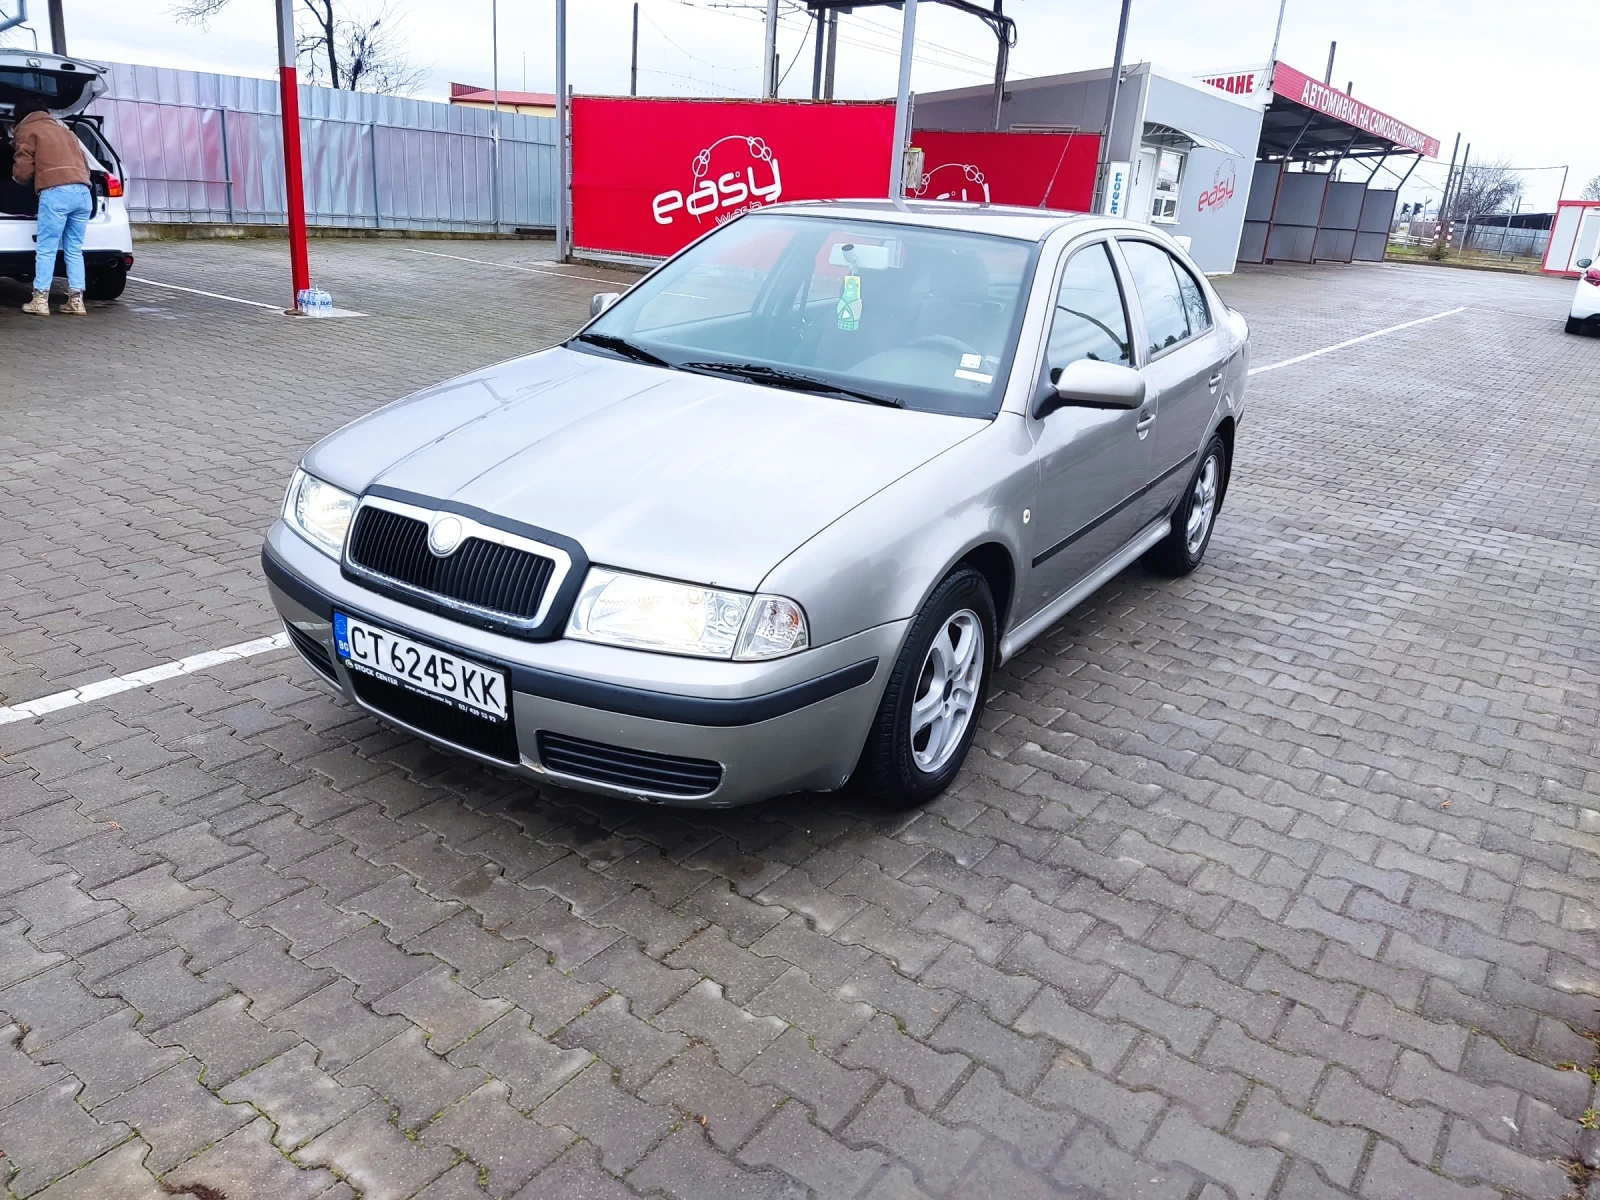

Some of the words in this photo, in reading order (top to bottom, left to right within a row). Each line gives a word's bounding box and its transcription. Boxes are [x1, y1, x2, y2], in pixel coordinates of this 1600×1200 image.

[1301, 80, 1359, 124] АВТОМИВКА
[1359, 105, 1370, 129] НА
[652, 158, 782, 225] easy
[1111, 172, 1122, 215] areon
[1198, 174, 1236, 212] easy
[338, 640, 350, 653] BG
[351, 626, 384, 665] CT
[391, 642, 457, 692] 6245
[462, 666, 501, 709] KK
[354, 663, 374, 677] STOCK
[375, 671, 399, 686] CENTER
